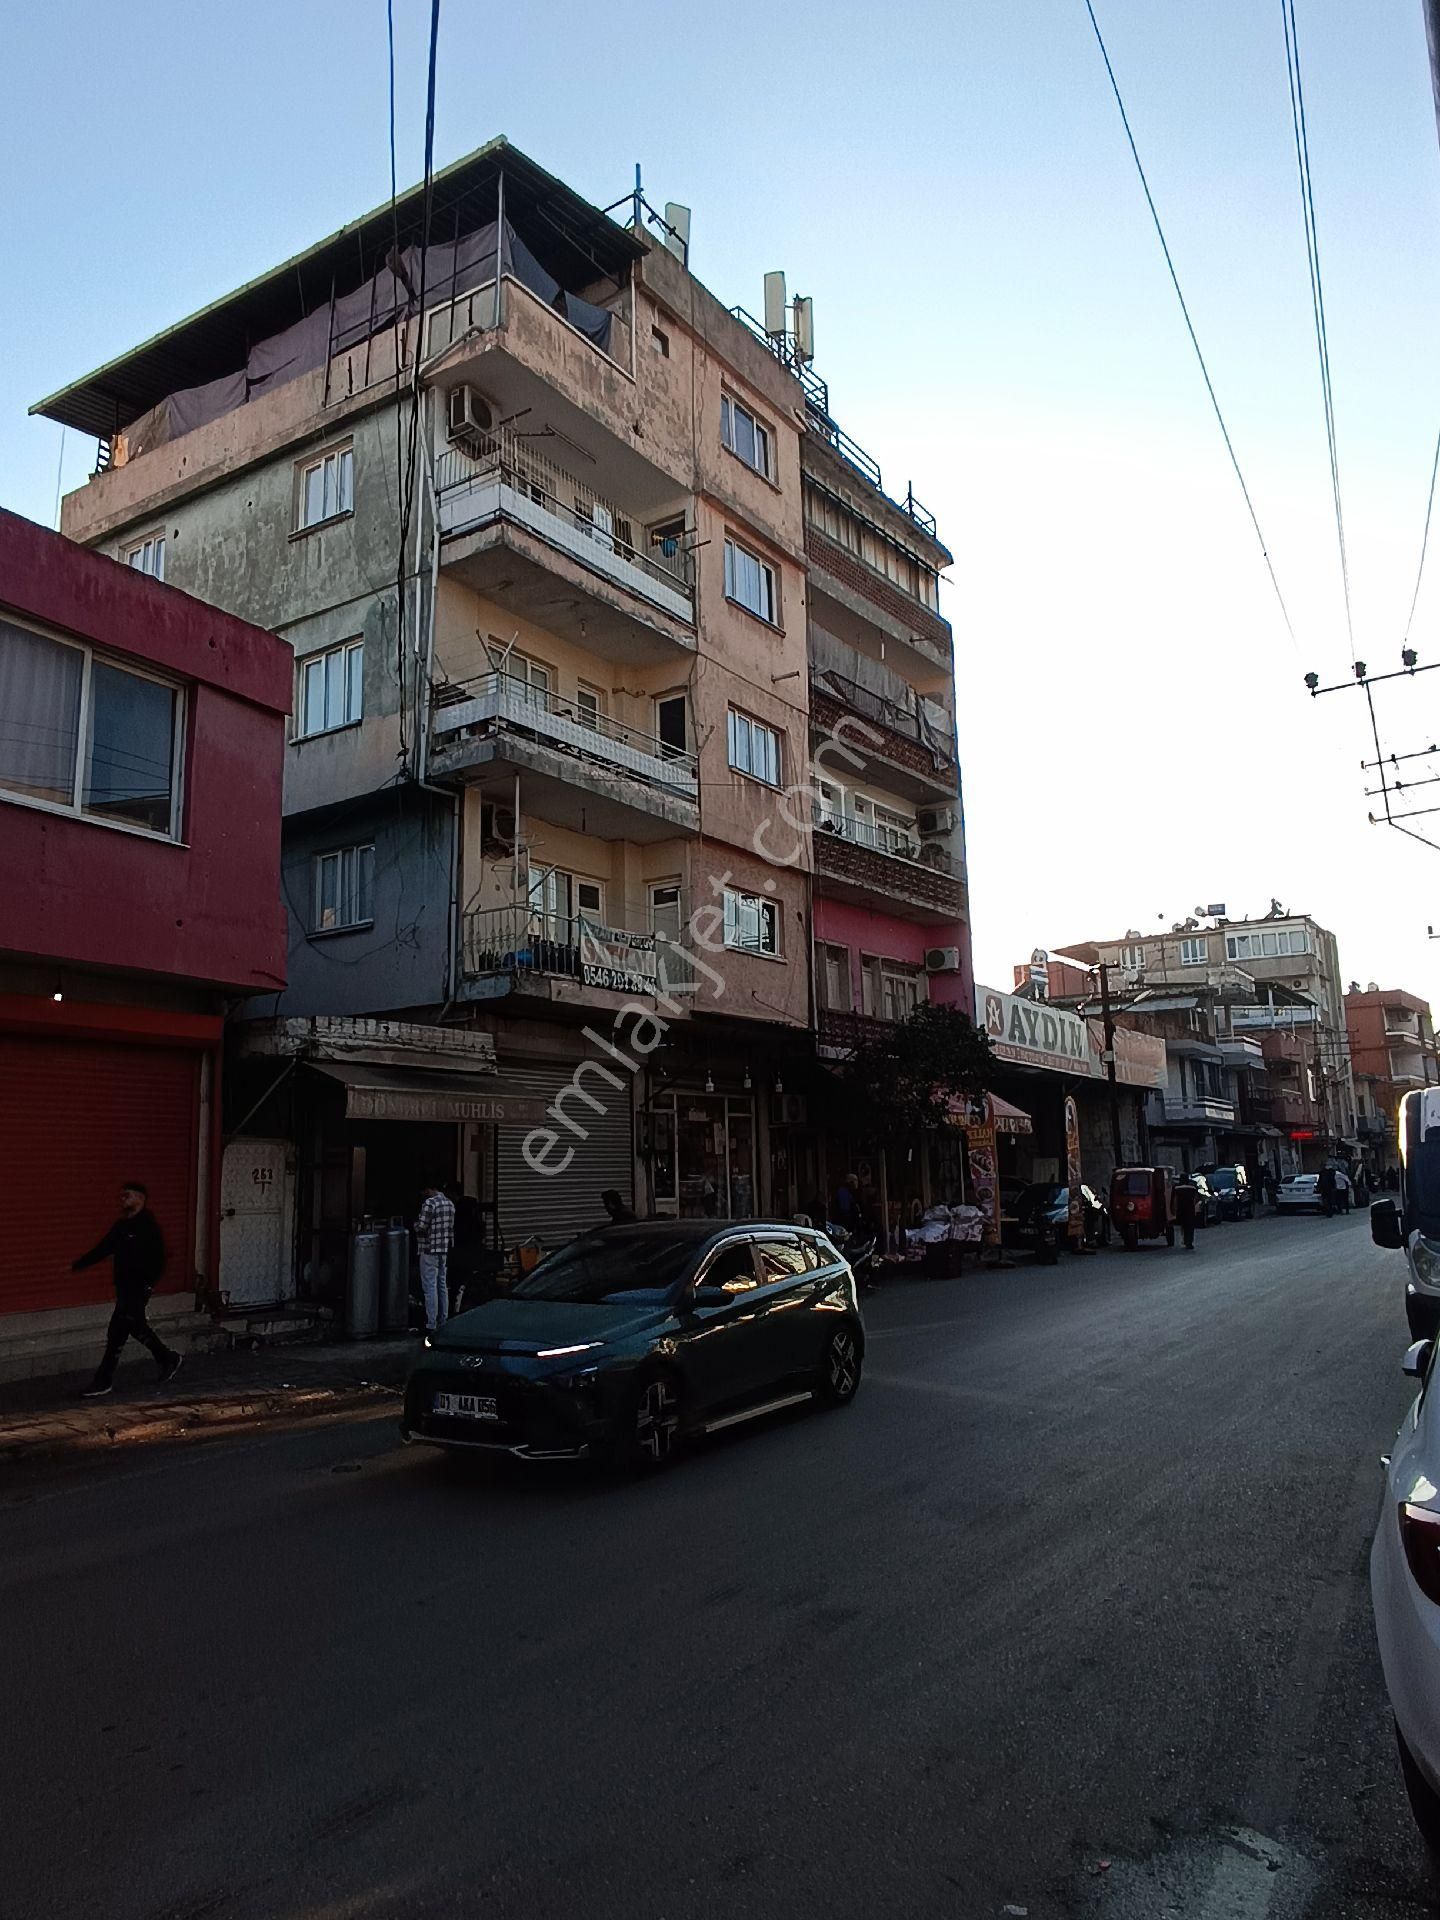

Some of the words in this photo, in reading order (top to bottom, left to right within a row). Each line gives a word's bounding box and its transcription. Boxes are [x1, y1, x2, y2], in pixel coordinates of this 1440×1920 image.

[584, 965, 609, 988] 0546
[1008, 1004, 1083, 1058] AYDIN
[448, 1101, 504, 1119] MUHLİS
